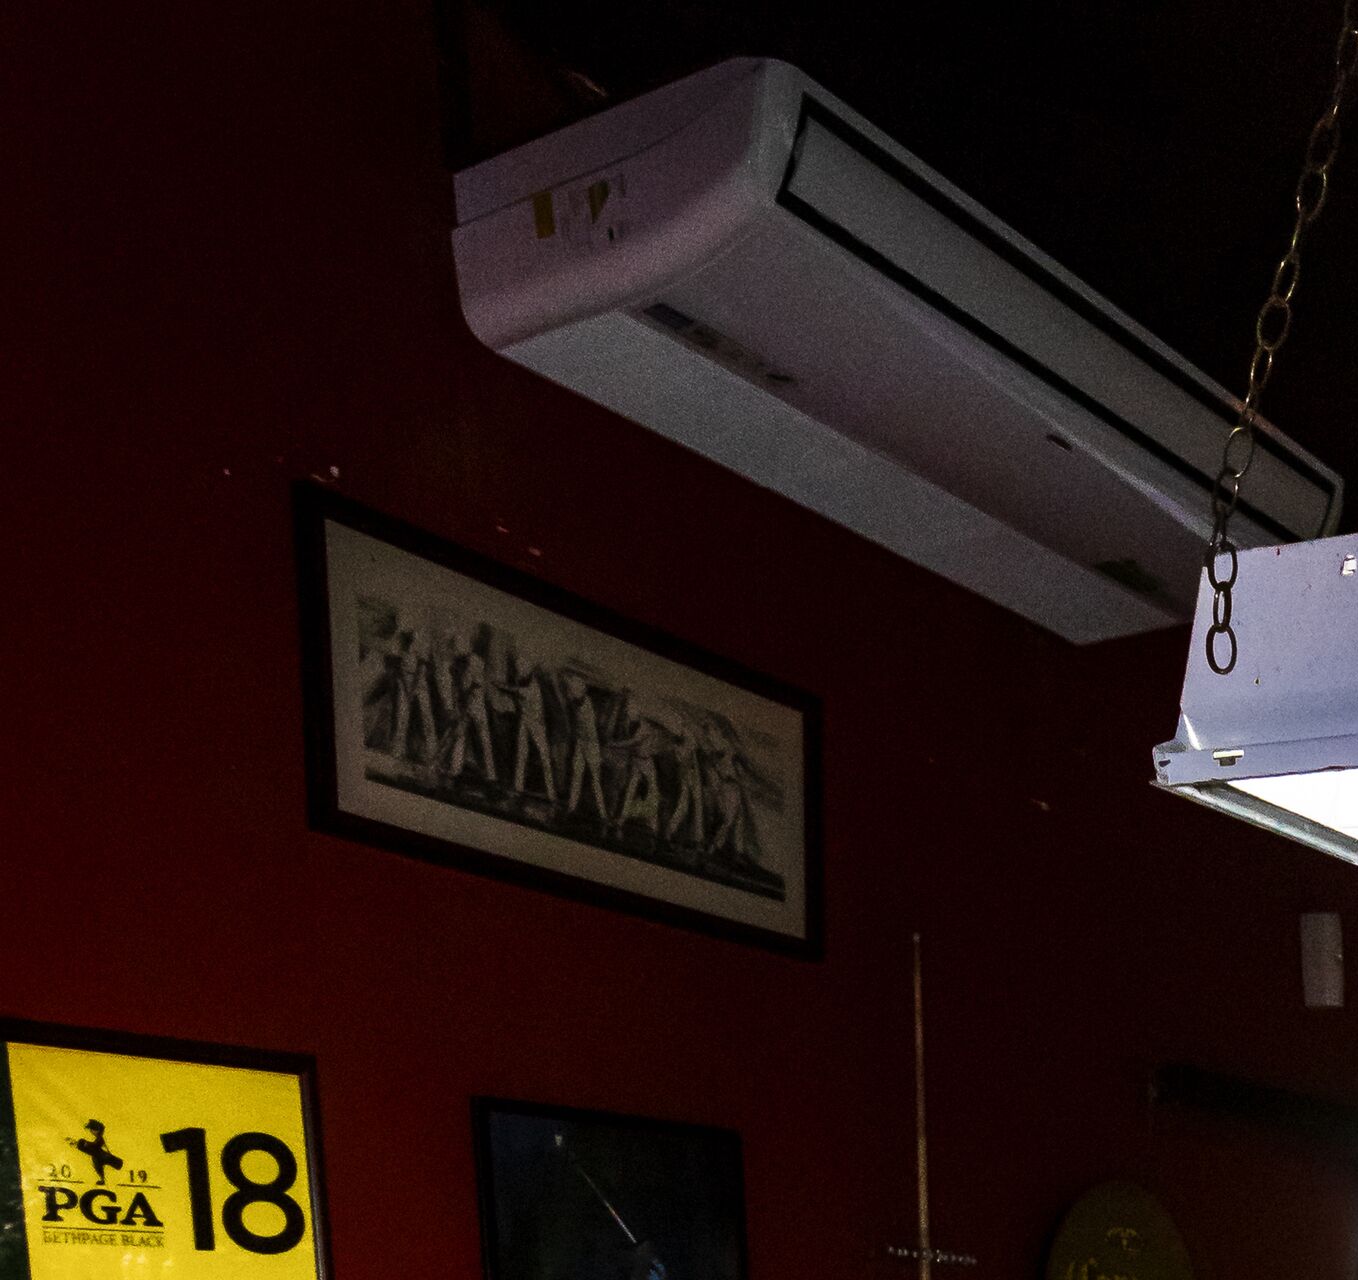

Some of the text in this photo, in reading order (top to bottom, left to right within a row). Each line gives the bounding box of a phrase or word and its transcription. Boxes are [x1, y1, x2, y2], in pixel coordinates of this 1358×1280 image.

[129, 1169, 148, 1183] 19
[160, 1127, 305, 1255] 18
[37, 1185, 164, 1227] PGA
